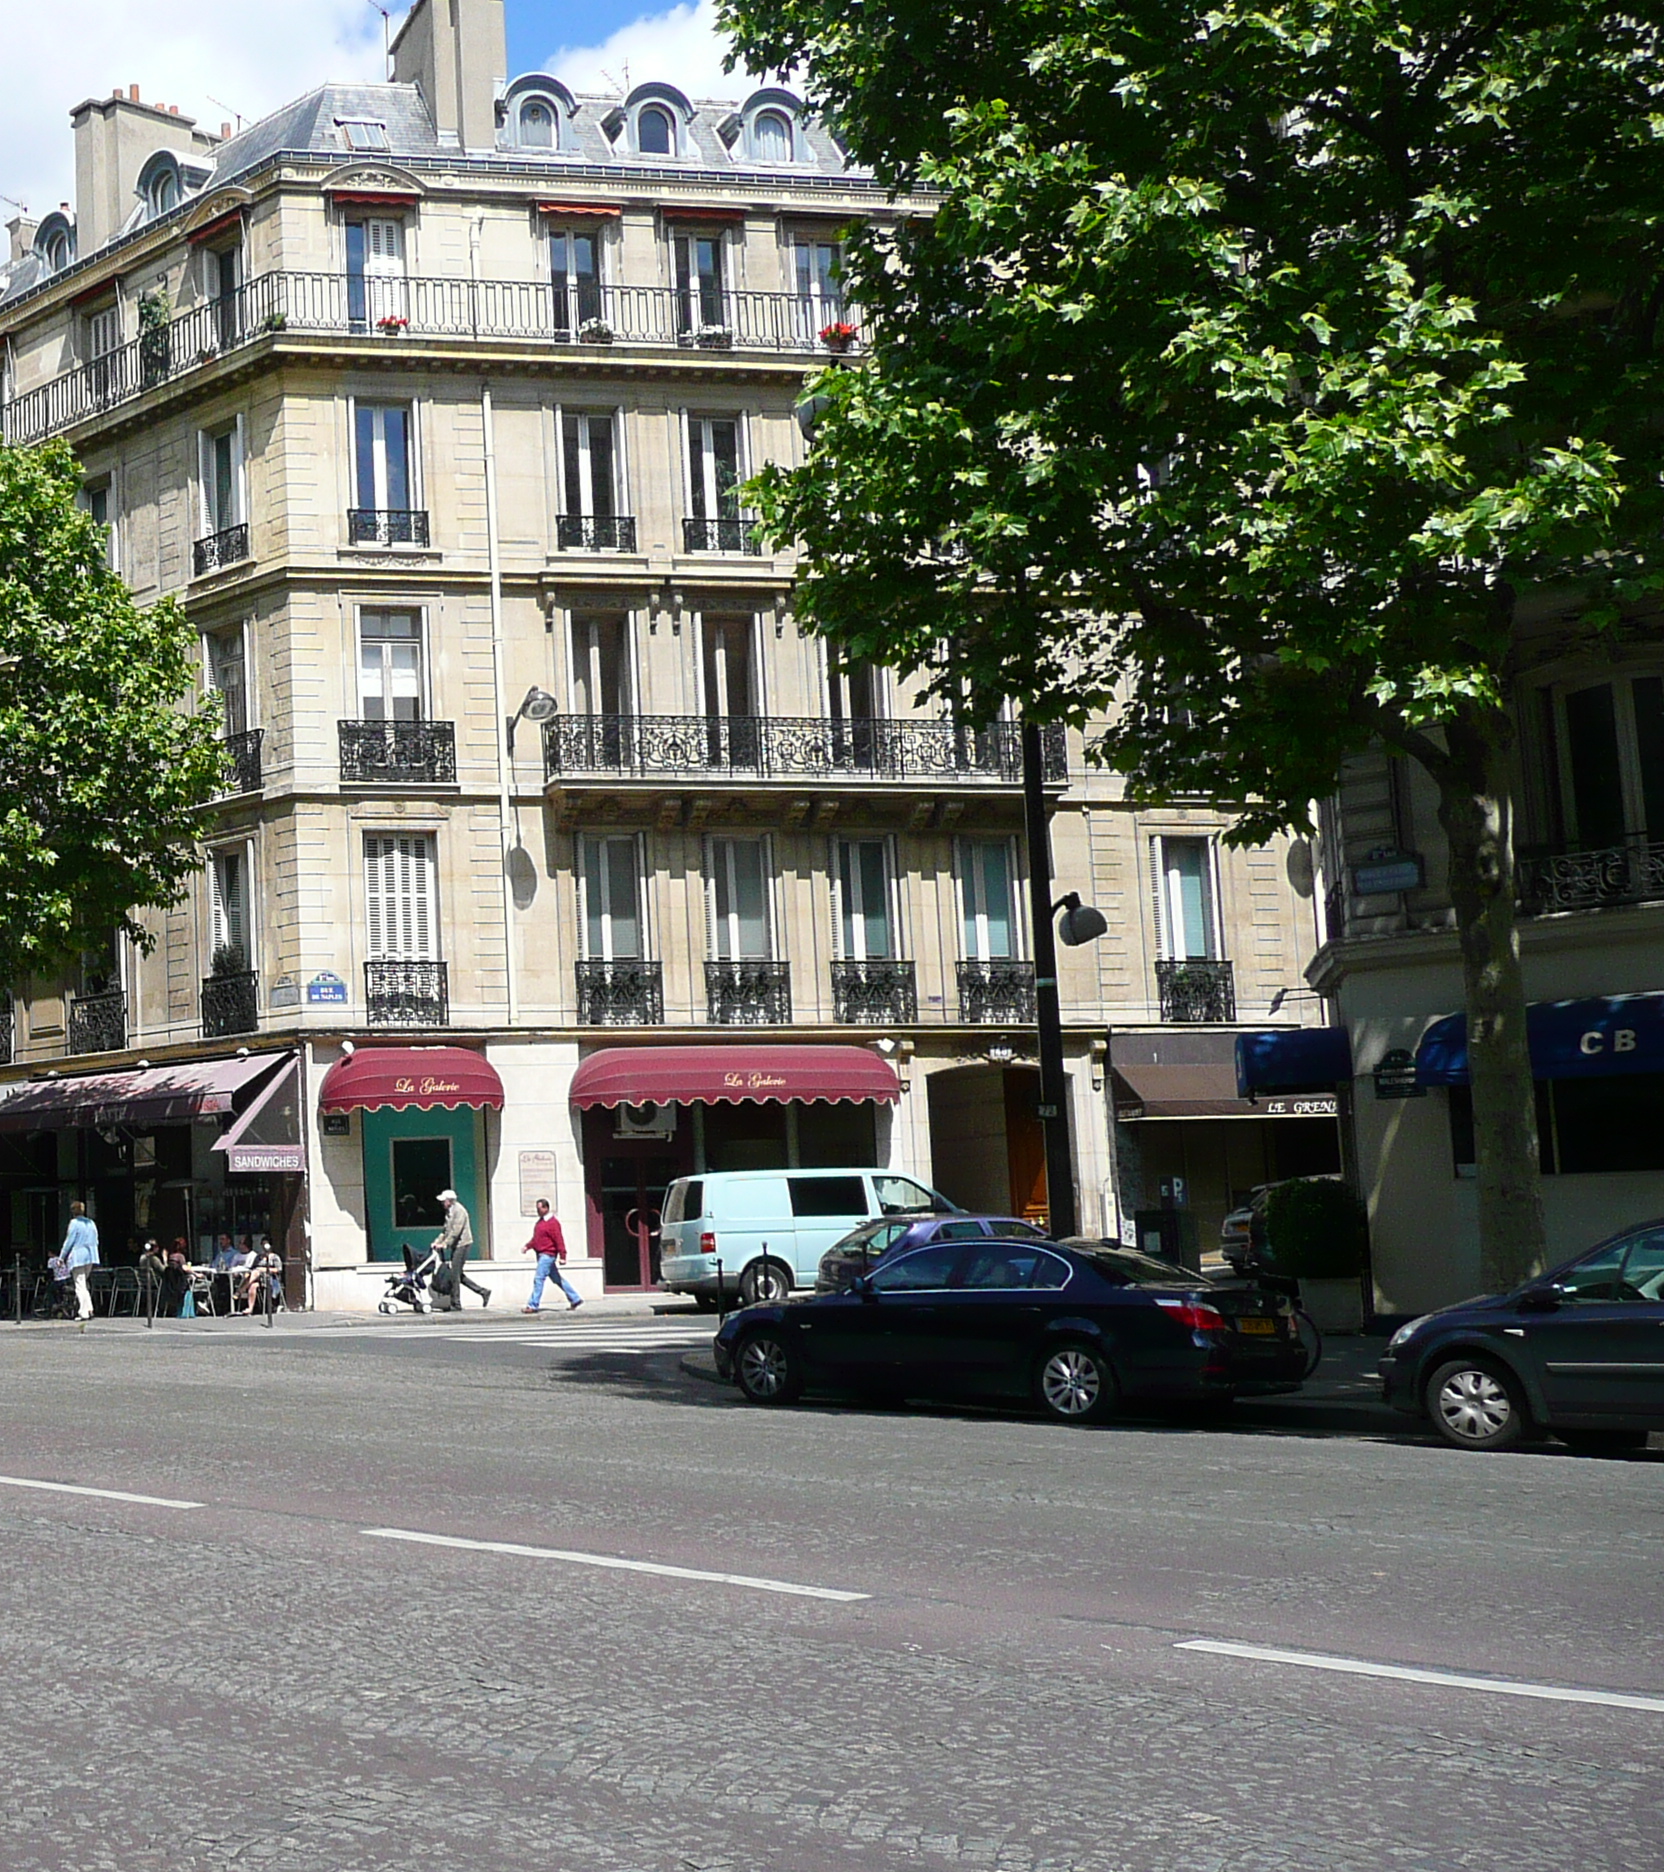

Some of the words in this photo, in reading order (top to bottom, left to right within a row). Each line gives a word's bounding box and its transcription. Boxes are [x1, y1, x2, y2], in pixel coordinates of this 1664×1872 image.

[394, 1077, 415, 1093] La
[419, 1076, 460, 1095] Galerie
[723, 1072, 743, 1087] La
[747, 1072, 787, 1088] Galerie
[1267, 1101, 1287, 1114] LE
[234, 1155, 300, 1168] SANDWICHES
